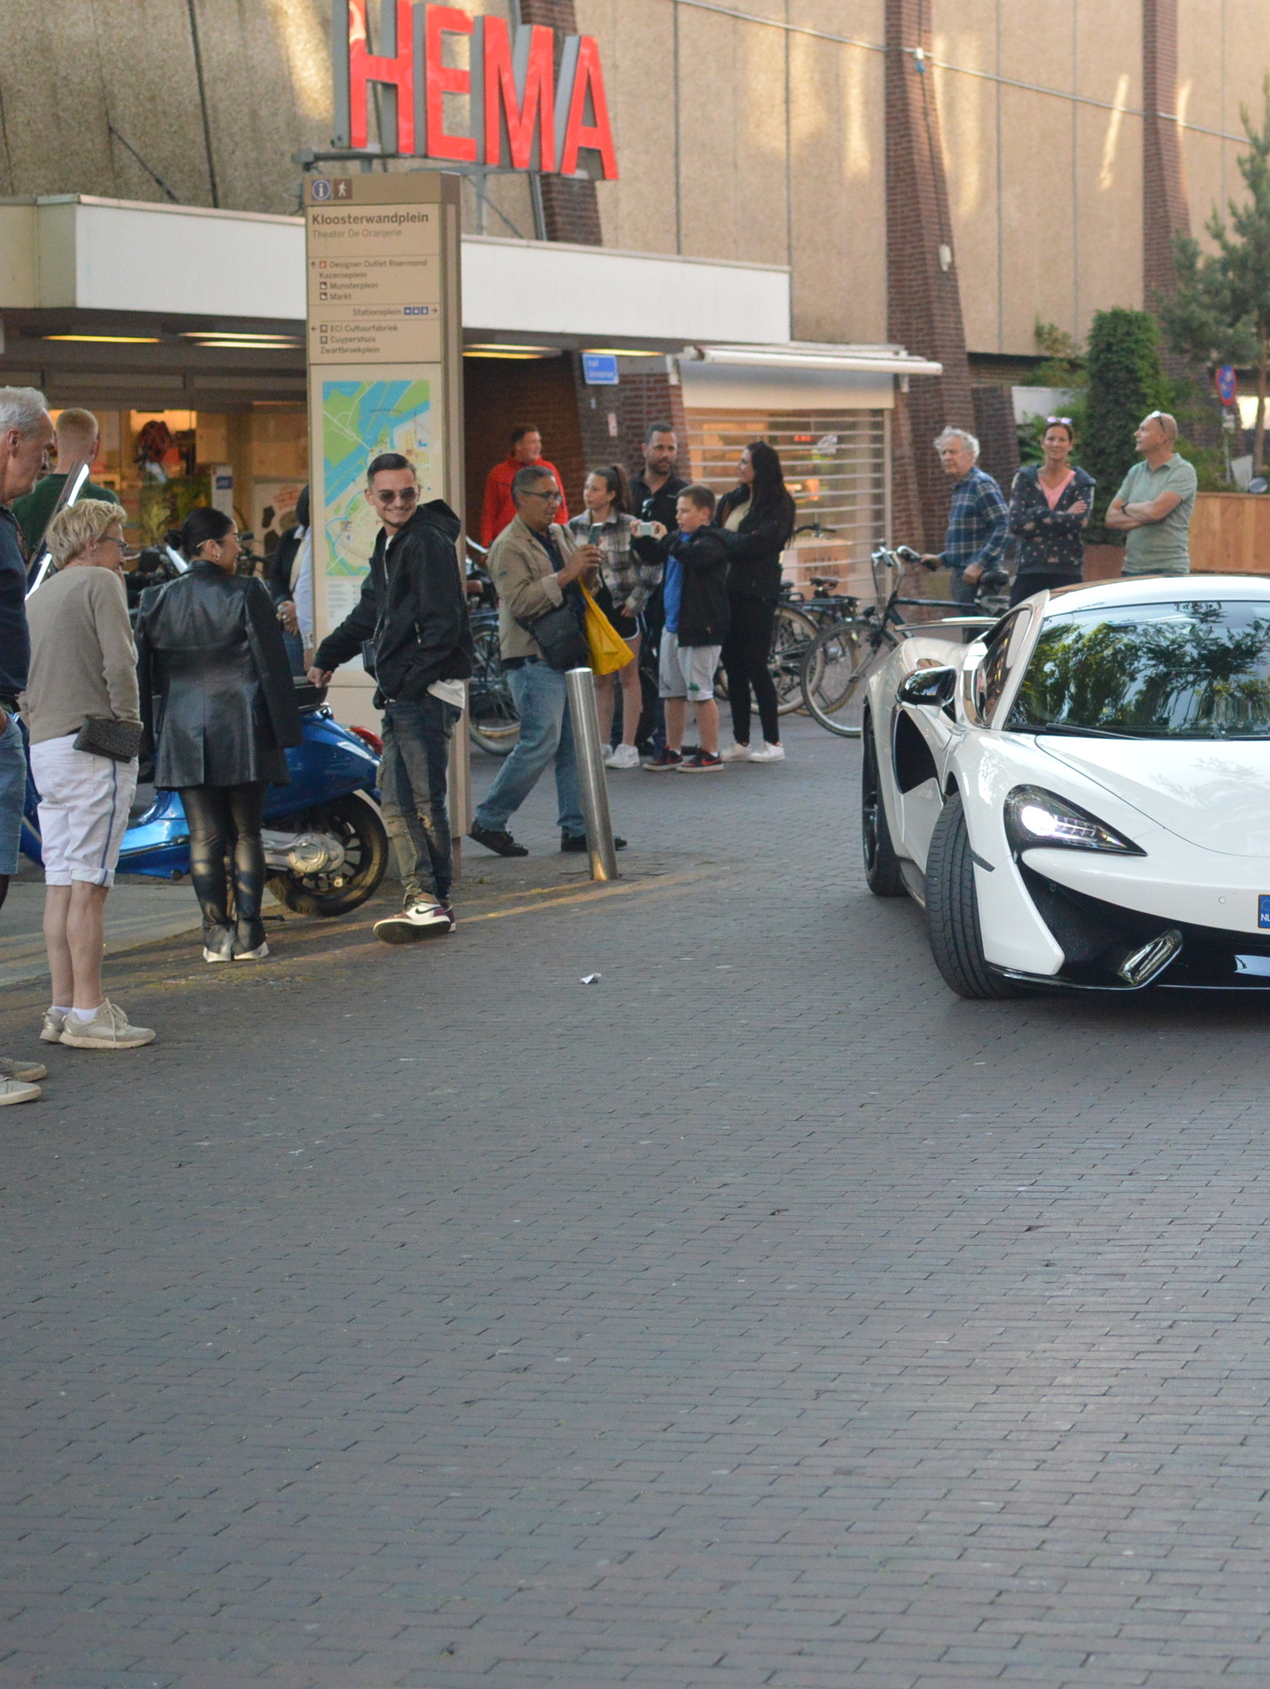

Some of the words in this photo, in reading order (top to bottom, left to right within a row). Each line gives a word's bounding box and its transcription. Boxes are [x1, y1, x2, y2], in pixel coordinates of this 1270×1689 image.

[347, 0, 619, 181] HEMA
[312, 212, 429, 226] Kloosterwandplein
[312, 230, 346, 239] Theater
[348, 229, 360, 238] De
[362, 229, 403, 239] Oranjerie
[329, 261, 362, 269] Designer
[364, 260, 387, 268] Outlet
[389, 259, 428, 267] Roermond
[319, 271, 368, 279] Kazerneplein
[329, 282, 379, 290] Munsterplein
[329, 292, 352, 300] Markt
[353, 308, 402, 317] Stationsplein
[330, 324, 343, 332] ECI
[345, 324, 398, 332] Cultuurfabriek
[330, 335, 376, 345] Cuypershuis
[320, 346, 380, 355] Zwartbroekplein
